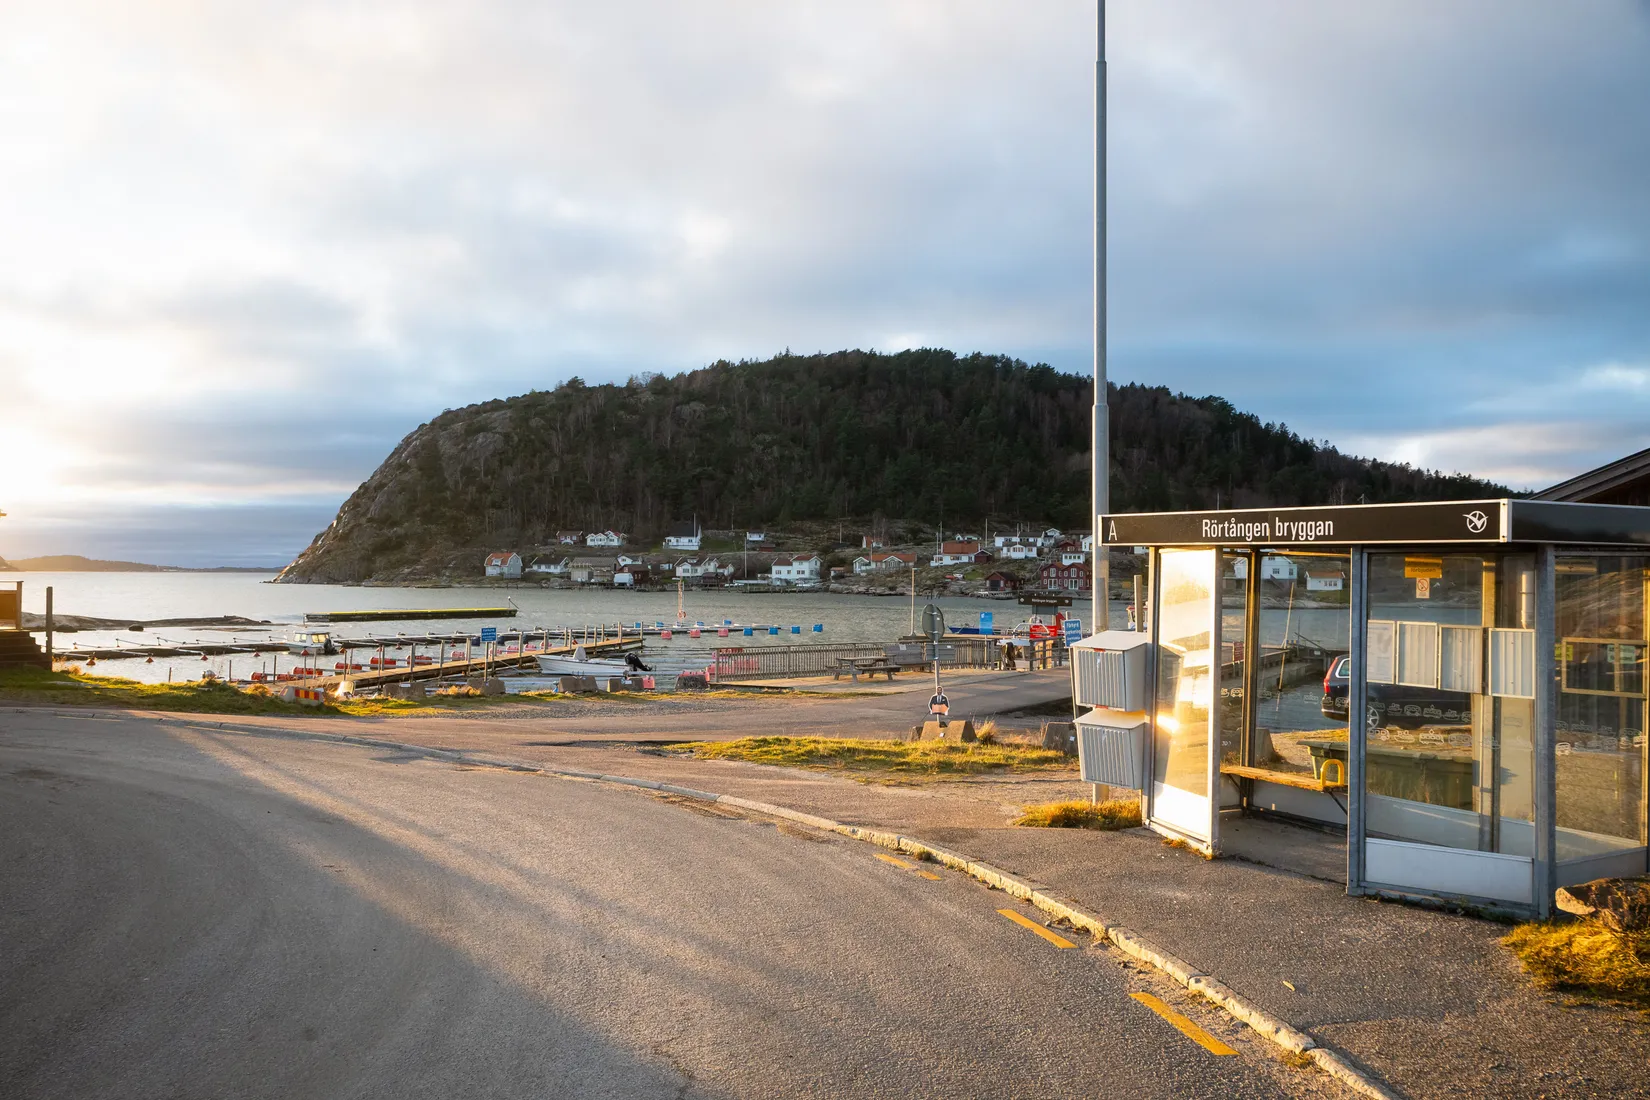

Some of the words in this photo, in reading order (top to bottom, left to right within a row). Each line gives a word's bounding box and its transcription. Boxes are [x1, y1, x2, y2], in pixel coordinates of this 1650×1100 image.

[1108, 520, 1118, 541] A
[1202, 517, 1269, 541] Rörtången
[1275, 517, 1334, 541] bryggan
